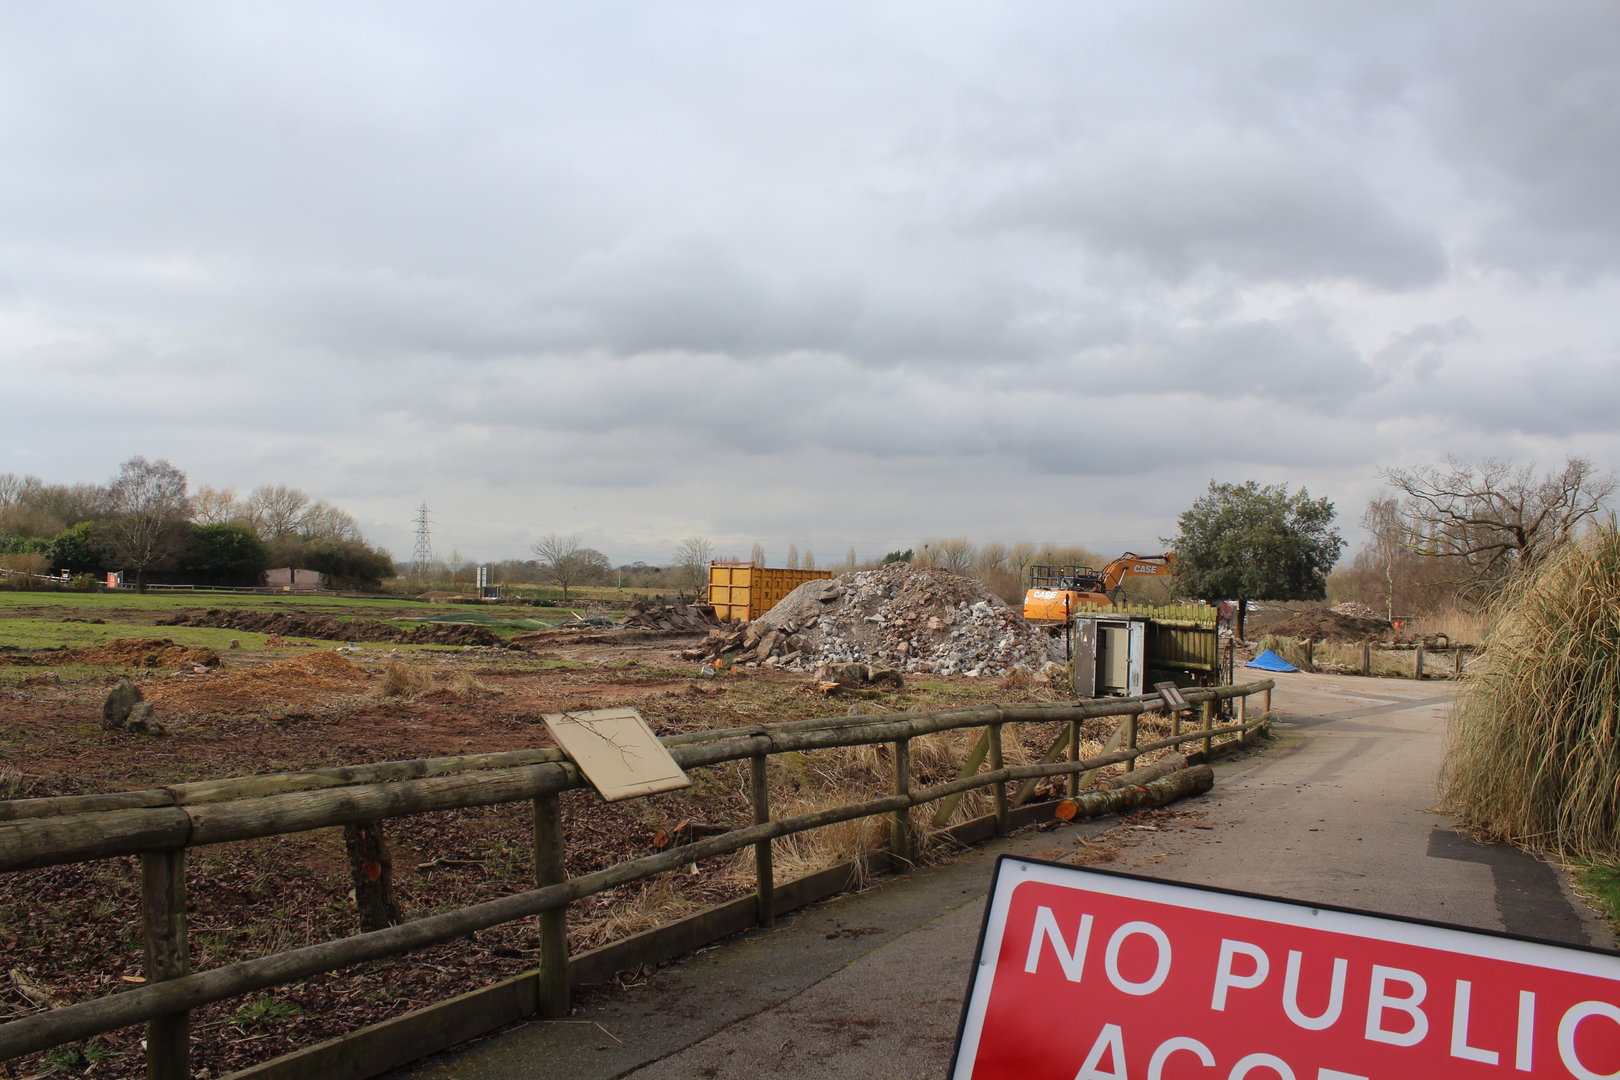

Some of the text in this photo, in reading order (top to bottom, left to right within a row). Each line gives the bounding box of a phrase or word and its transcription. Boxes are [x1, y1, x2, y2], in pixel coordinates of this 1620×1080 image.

[1134, 565, 1157, 574] CASE
[1033, 591, 1058, 599] CASE
[1025, 906, 1620, 1080] NO PUBLIC
